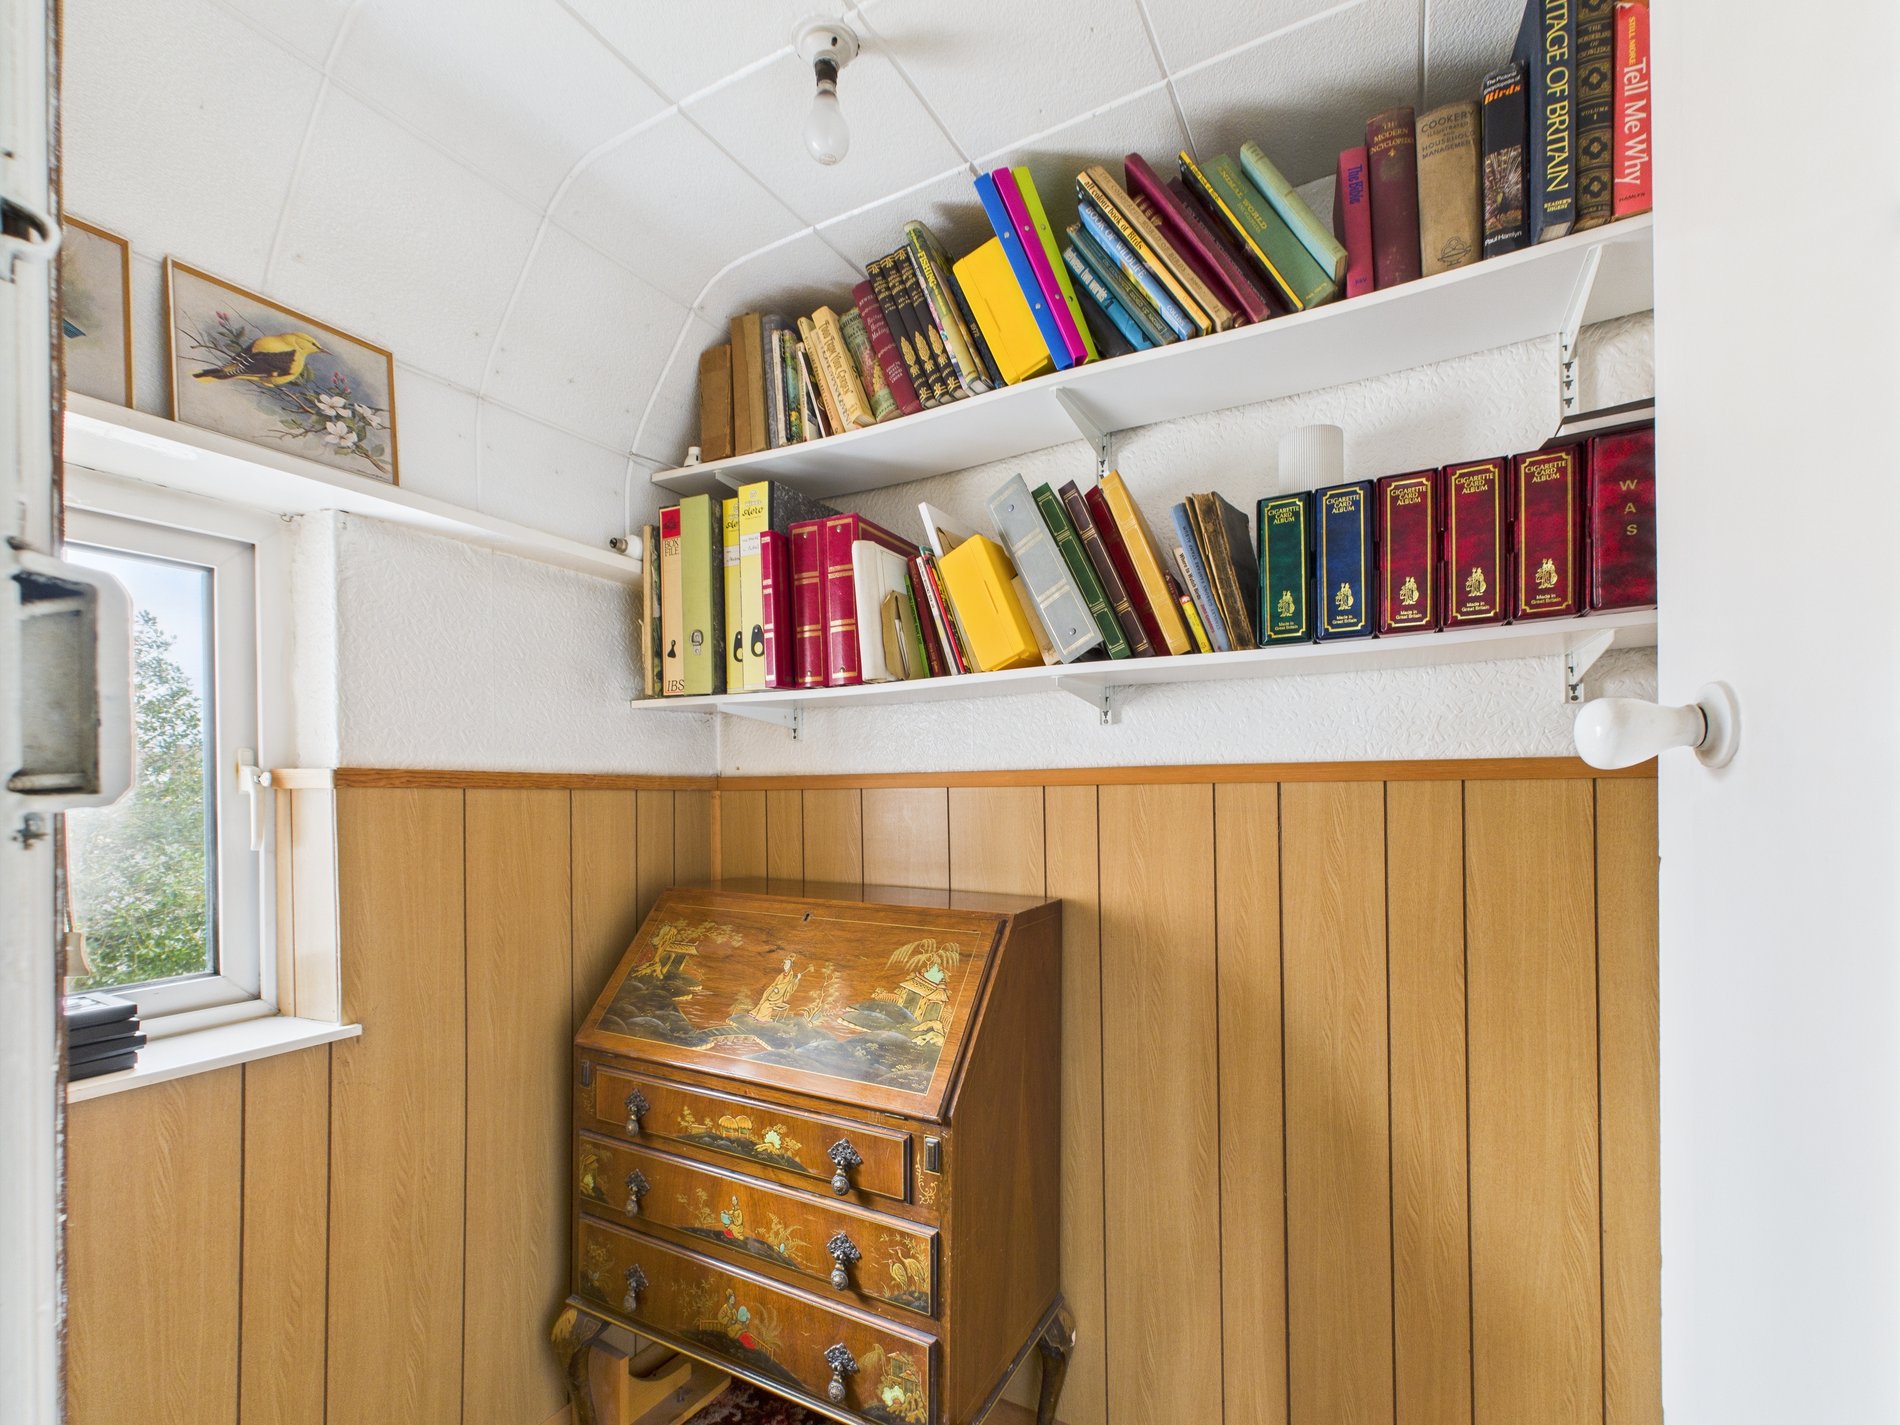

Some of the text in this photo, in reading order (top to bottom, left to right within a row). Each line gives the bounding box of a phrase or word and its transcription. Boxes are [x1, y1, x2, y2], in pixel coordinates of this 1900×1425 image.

[1628, 15, 1636, 65] STILL MORE
[1483, 84, 1521, 106] Birds
[1546, 0, 1569, 192] ITAGE OF BRITAIN
[1421, 110, 1475, 134] COOKERY
[1614, 56, 1649, 185] Tell Me Why
[1374, 127, 1409, 145] MODERN
[1347, 163, 1364, 205] The Bible
[1241, 197, 1268, 229] WORLD
[1546, 203, 1569, 213] DIGEST
[1084, 181, 1144, 250] all colour book of Birds
[1085, 206, 1104, 231] BOOK
[1104, 228, 1117, 241] OF
[1116, 240, 1147, 278] WILDLIFE
[1498, 230, 1522, 241] Hamlyn
[918, 251, 937, 286] FISHING
[1168, 252, 1186, 272] BIRDS
[1165, 303, 1186, 326] COLLINS
[1525, 460, 1567, 473] CIGARETTE
[1535, 467, 1557, 476] CARD
[1455, 472, 1494, 485] CIGARETTE
[1464, 479, 1485, 487] CARD
[1532, 473, 1560, 483] ALBUM
[1391, 485, 1427, 497] CIGARETTE
[1462, 485, 1488, 494] ALBUM
[1326, 494, 1360, 505] CIGARETTE
[1333, 500, 1352, 508] CARD
[1396, 497, 1421, 506] ALBUM
[1268, 505, 1300, 516] CIGARETTE
[1332, 506, 1355, 514] ALBUM
[725, 520, 738, 529] Ae
[1273, 517, 1295, 525] ALBUM
[1182, 526, 1191, 545] ALBUM
[664, 537, 680, 549] BOX
[664, 547, 680, 557] FILE
[1188, 545, 1197, 562] STAMP
[1179, 553, 1188, 568] Where
[1188, 573, 1197, 588] Watch
[1193, 587, 1201, 600] Birds
[1203, 584, 1213, 607] GIBBONS
[667, 679, 685, 692] IBS
